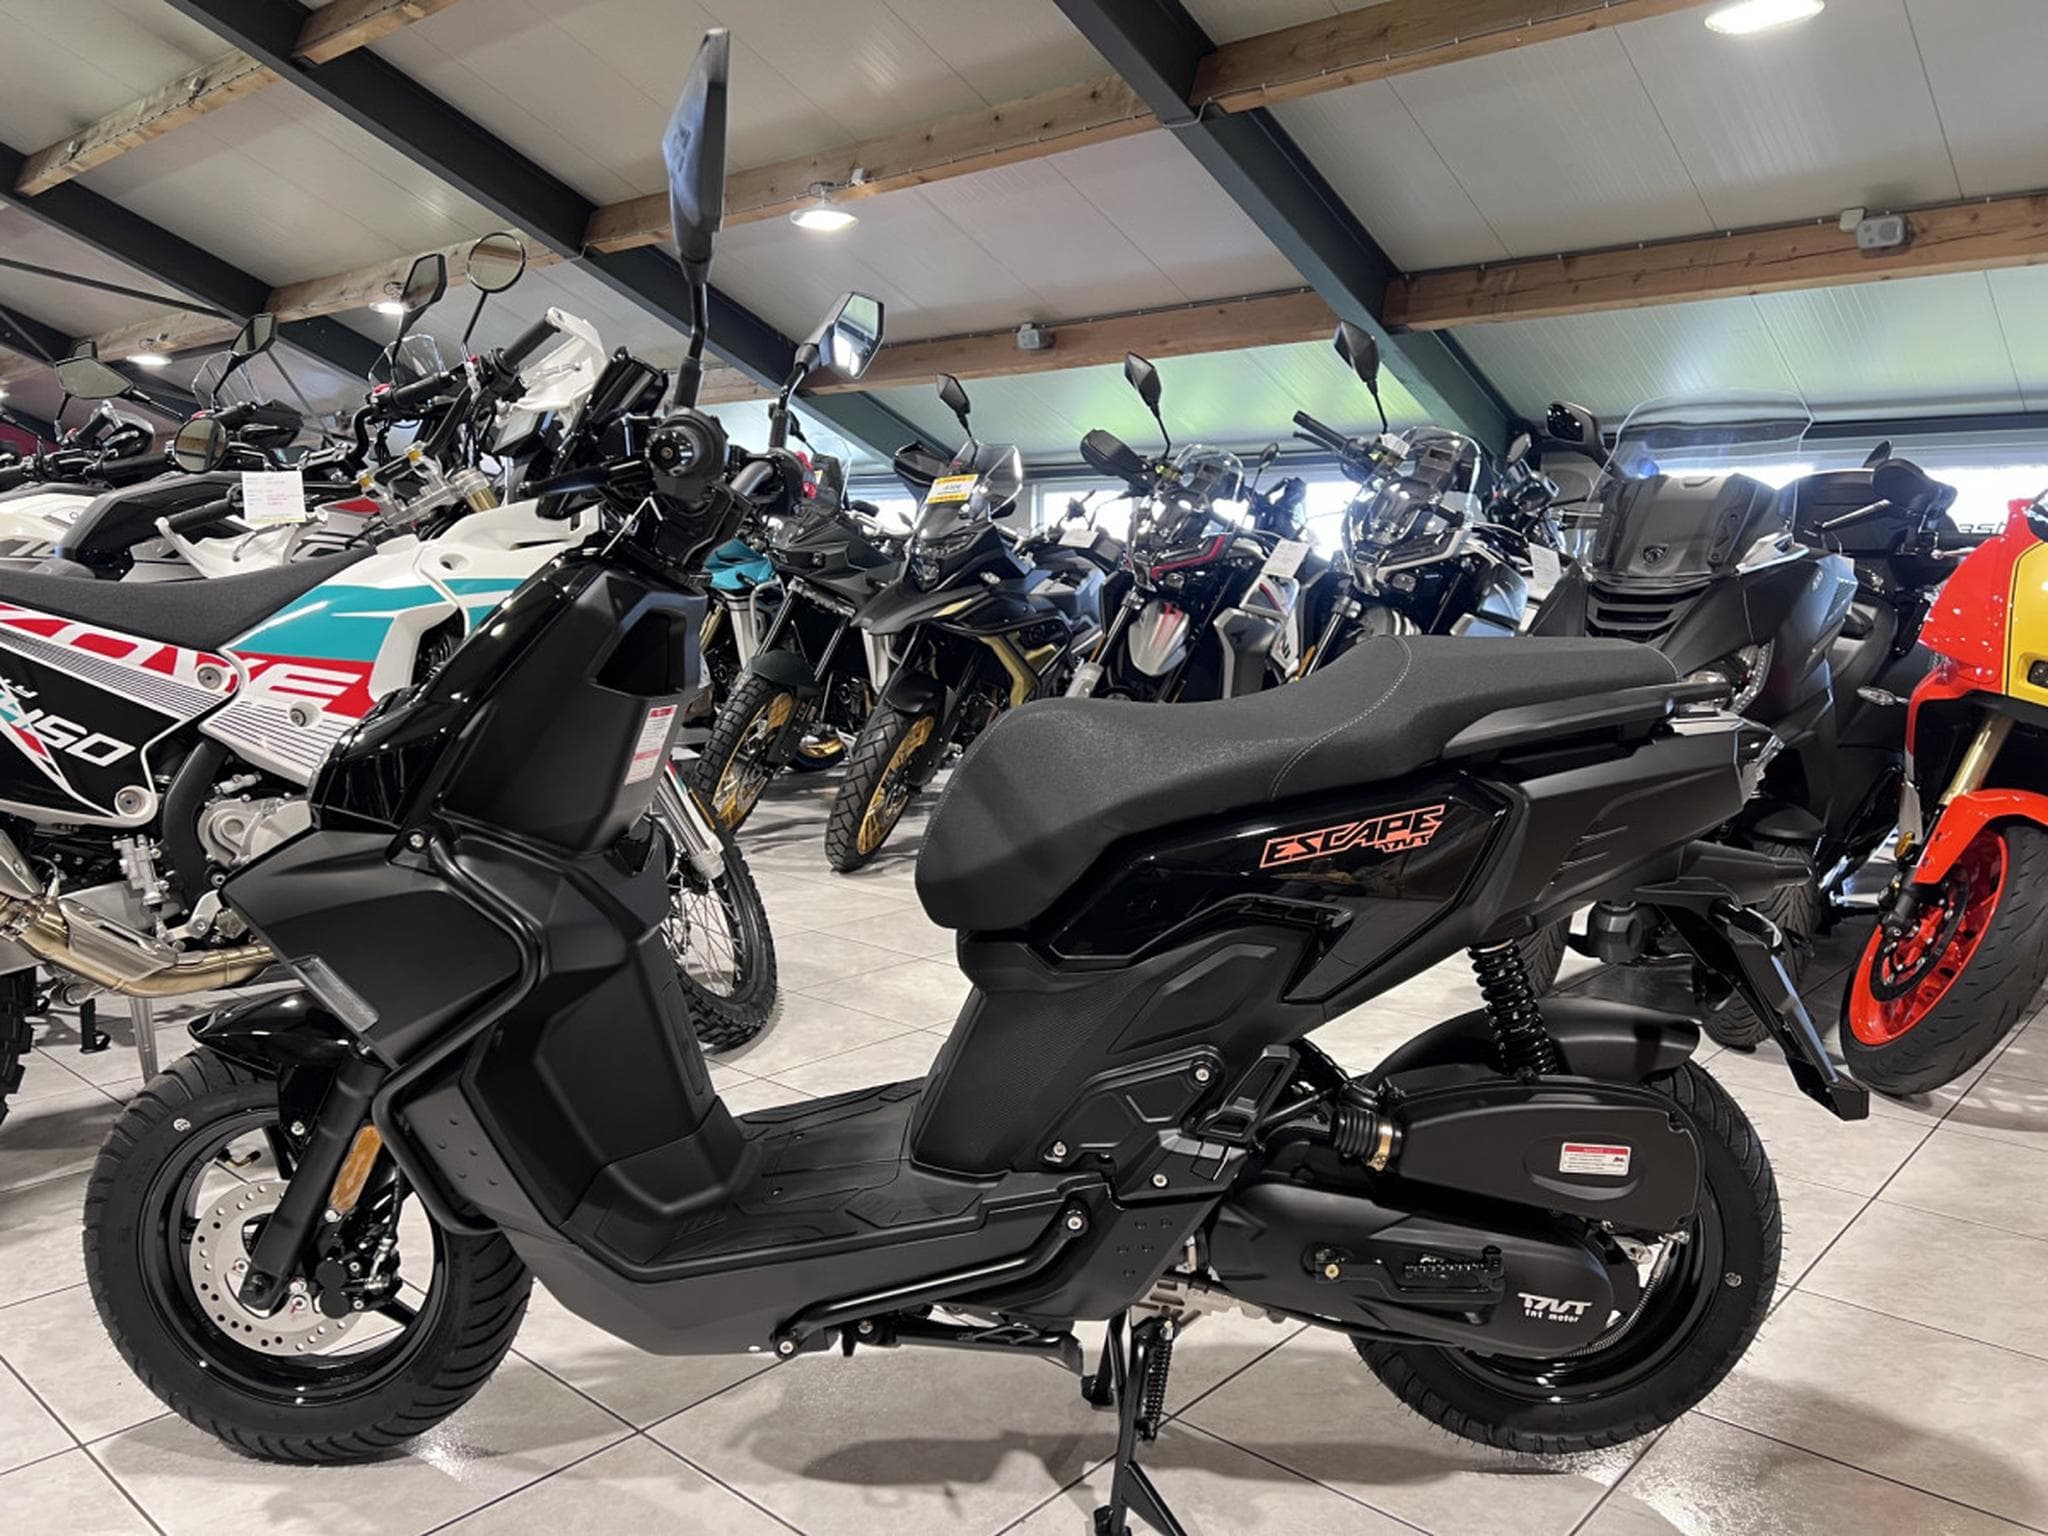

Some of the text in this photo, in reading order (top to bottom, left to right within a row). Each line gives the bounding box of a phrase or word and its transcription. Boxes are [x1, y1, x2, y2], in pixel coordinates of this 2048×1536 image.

[1259, 804, 1446, 868] ESCAPE
[1517, 1292, 1592, 1315] TNT
[1548, 1313, 1579, 1323] motor
